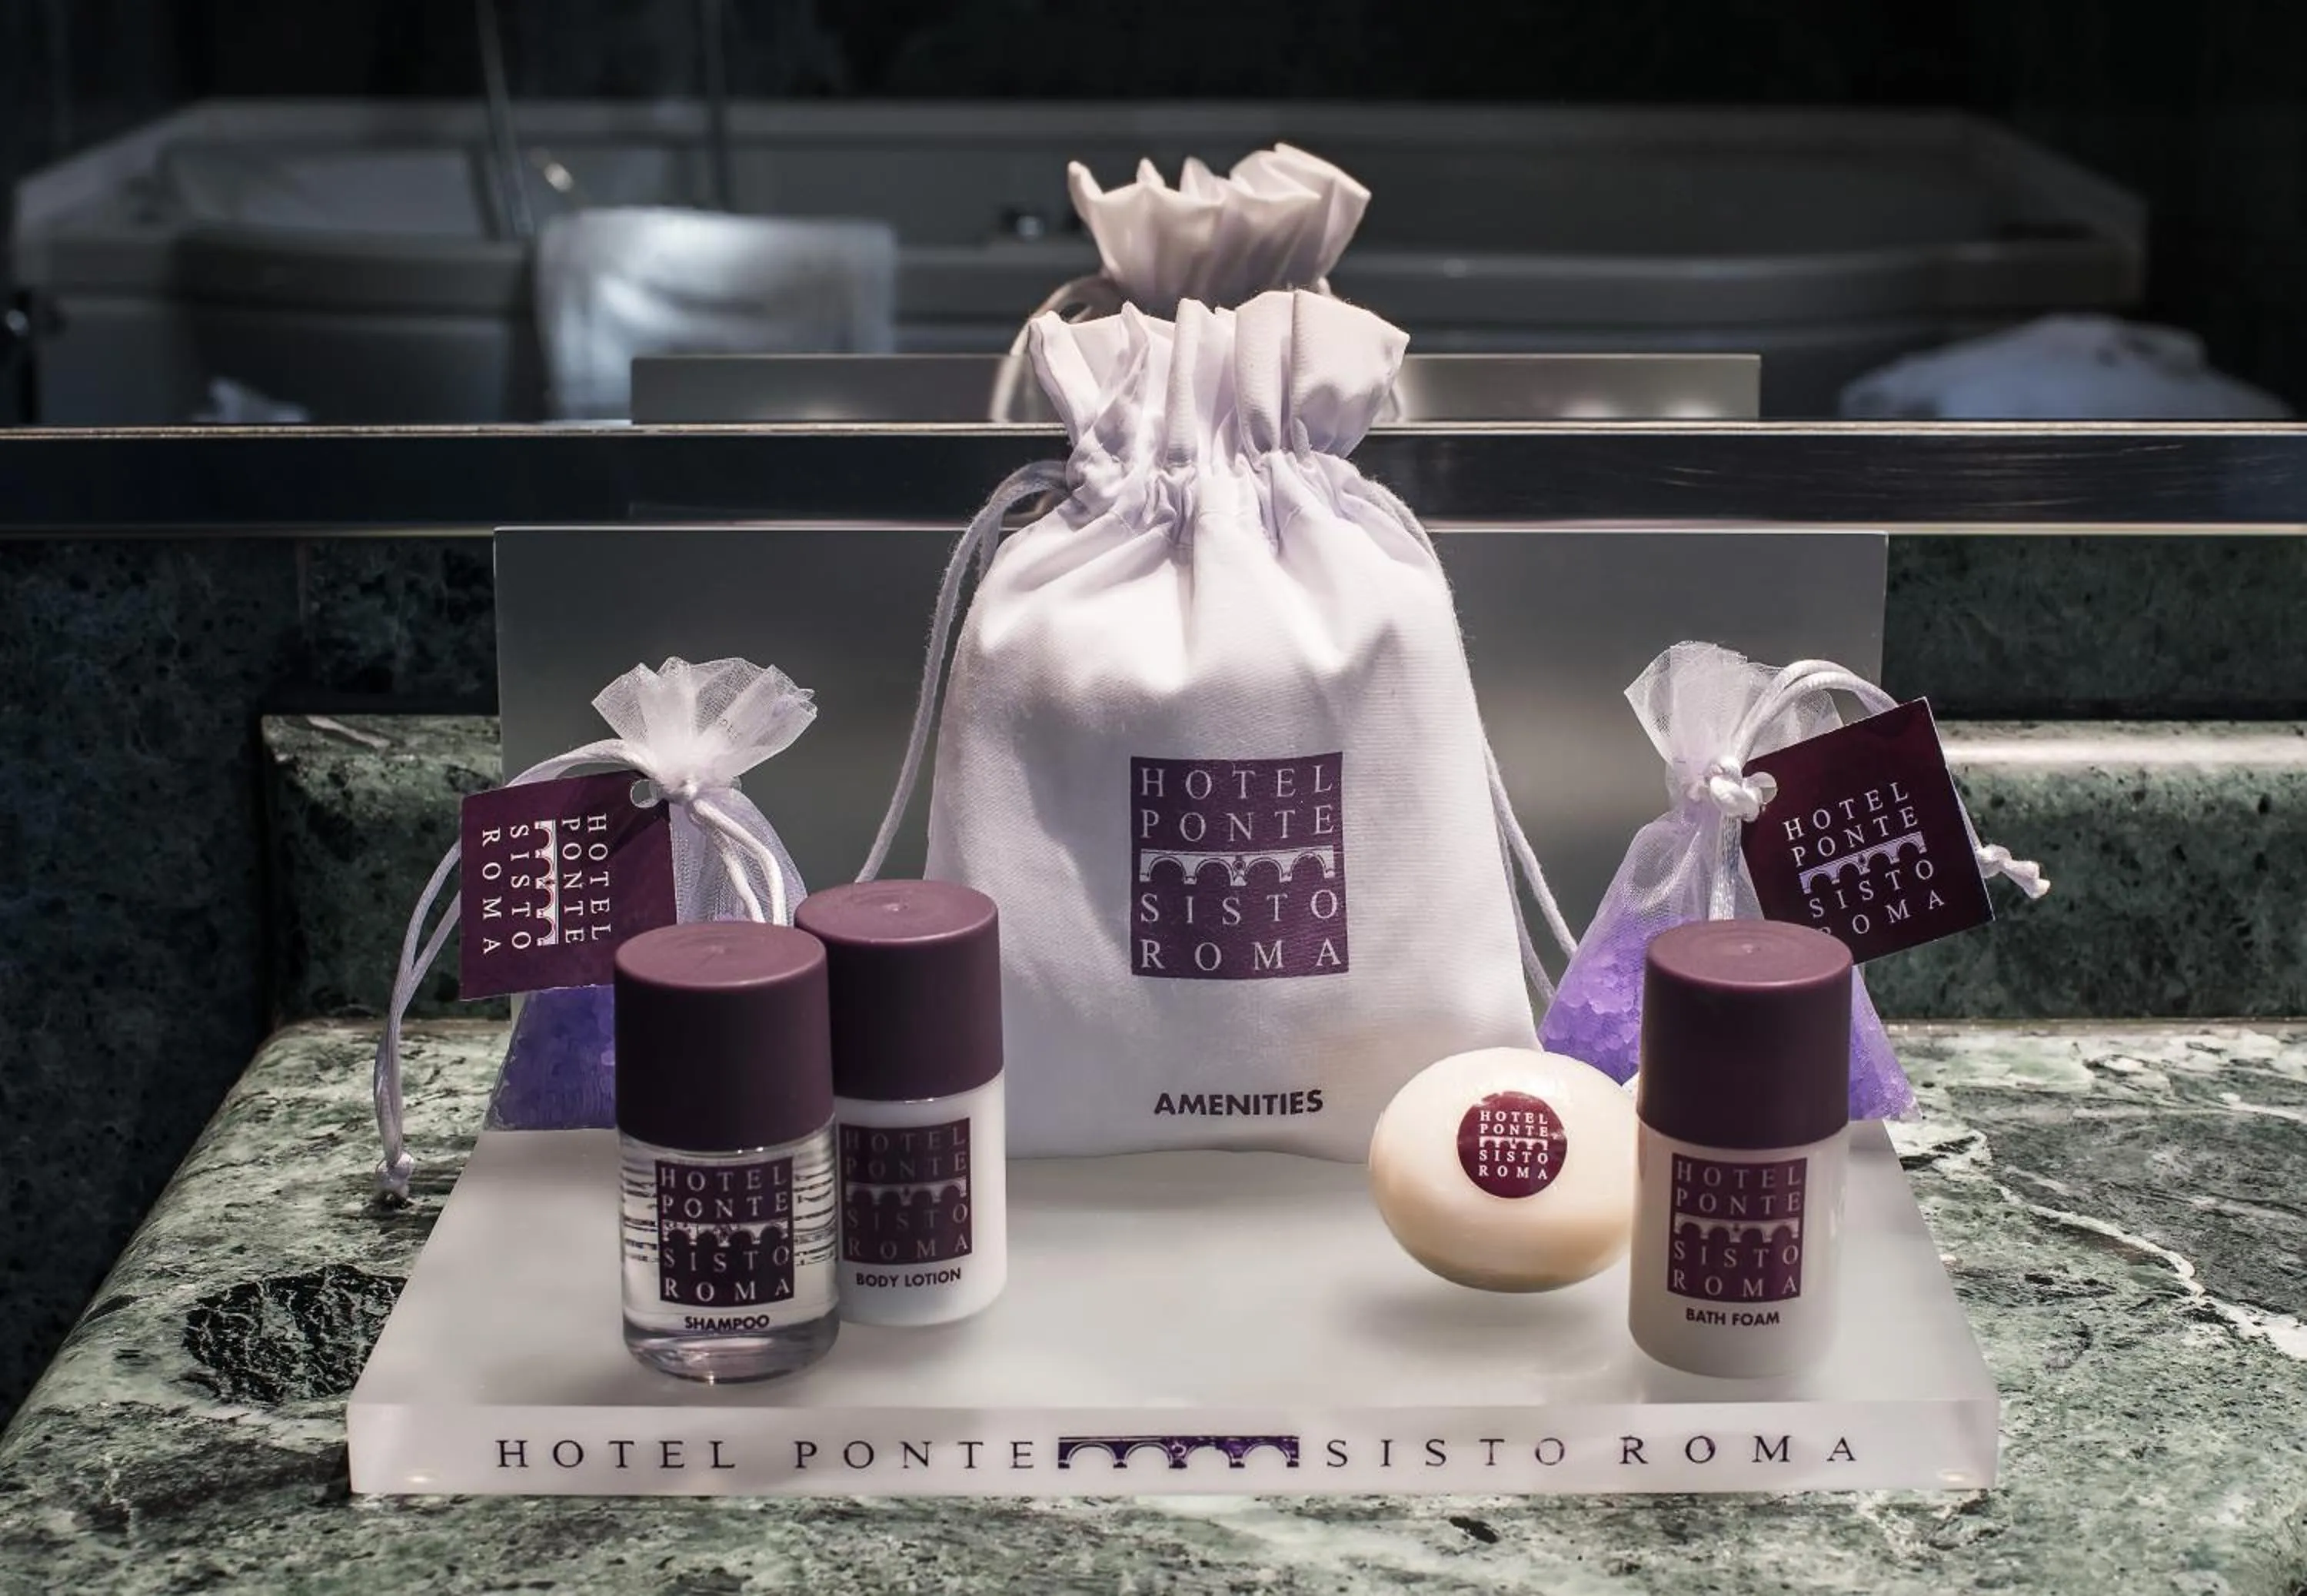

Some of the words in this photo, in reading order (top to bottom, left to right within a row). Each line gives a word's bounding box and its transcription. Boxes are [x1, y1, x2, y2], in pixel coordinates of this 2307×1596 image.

[1140, 764, 1333, 800] HOTEL
[1140, 803, 1334, 843] PONTE
[1782, 781, 1909, 841] HOTEL
[1790, 806, 1919, 868] PONTE
[481, 826, 502, 955] ROMA
[510, 823, 531, 950] SISTO
[561, 817, 585, 945] PONTE
[587, 812, 611, 941] HOTEL
[1808, 859, 1935, 919] SISTO
[1140, 889, 1338, 926] SISTO
[1818, 889, 1945, 936] OMA
[1140, 937, 1343, 972] ROMA
[1154, 1089, 1324, 1116] AMENITIES
[1479, 1109, 1549, 1125] HOTEL
[845, 1125, 967, 1153] HOTEL
[1479, 1122, 1549, 1137] PONTE
[846, 1154, 967, 1178] PONTE
[1478, 1149, 1549, 1165] SISTO
[660, 1165, 787, 1192] HOTEL
[1478, 1165, 1548, 1180] ROMA
[1676, 1159, 1802, 1190] HOTEL
[661, 1192, 789, 1219] PONTE
[1676, 1186, 1801, 1215] PONTE
[847, 1202, 968, 1230] SISTO
[663, 1245, 791, 1272] SISTO
[847, 1235, 969, 1260] ROMA
[1673, 1239, 1799, 1268] SISTO
[664, 1276, 792, 1302] ROMA
[855, 1272, 901, 1288] BODY
[904, 1268, 962, 1288] LOTION
[1673, 1268, 1798, 1298] ROMA
[684, 1313, 771, 1332] SHAMPOO
[1685, 1308, 1726, 1326] BATH
[1732, 1311, 1780, 1327] FOAM
[494, 1438, 736, 1471] HOTEL
[793, 1439, 1036, 1471] PONTE
[1326, 1436, 1567, 1468] SISTO
[1619, 1434, 1858, 1465] ROMA
